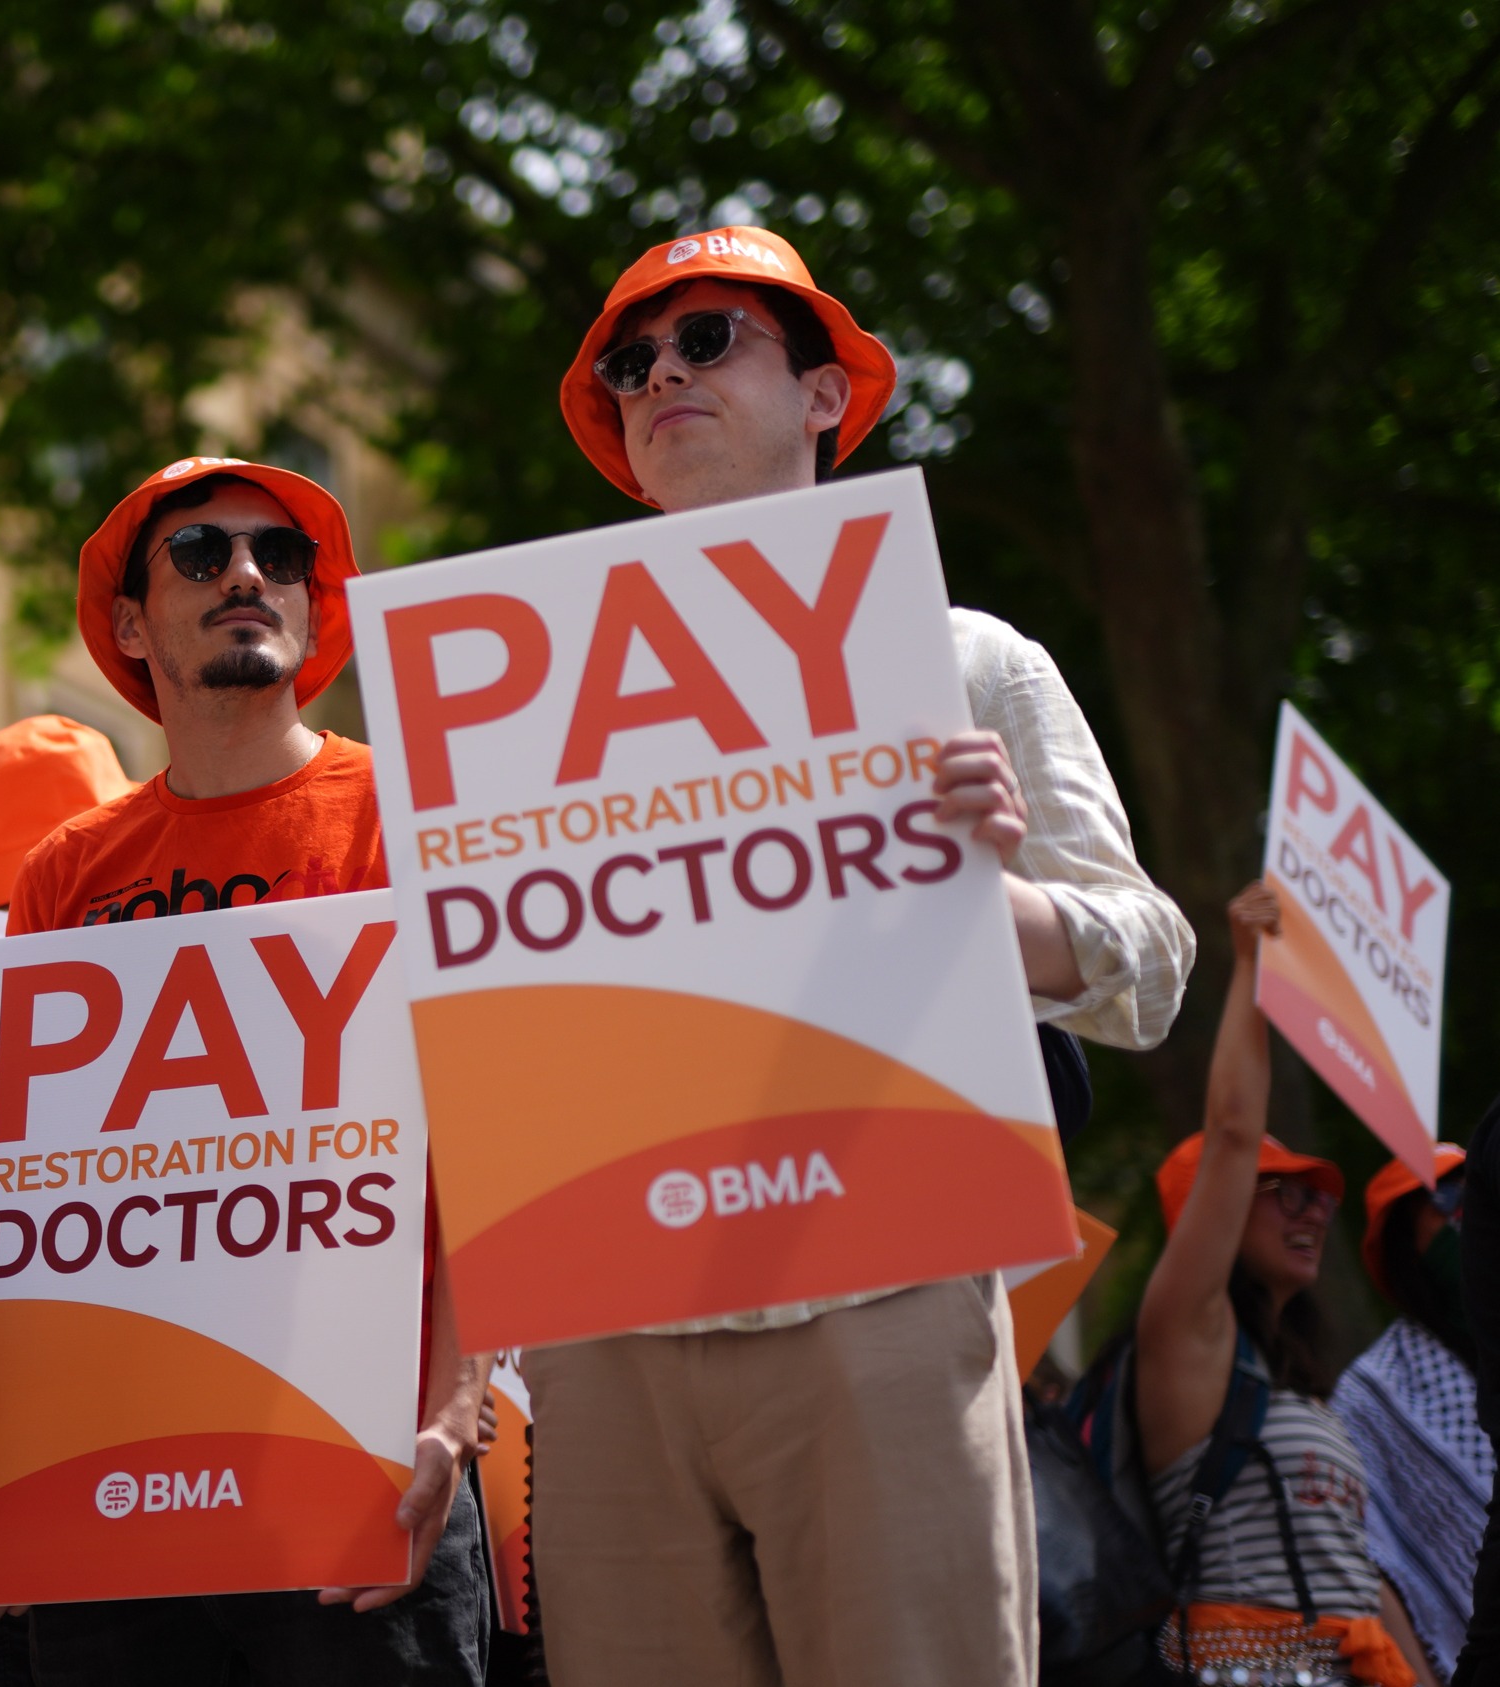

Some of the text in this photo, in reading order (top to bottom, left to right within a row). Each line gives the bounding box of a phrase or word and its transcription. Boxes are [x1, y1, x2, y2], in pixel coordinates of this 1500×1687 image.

[707, 235, 787, 272] BMA
[383, 511, 892, 813] PAY
[416, 736, 940, 872] RESTORATION FOR
[1286, 729, 1438, 944] PAY
[425, 798, 964, 970] DOCTORS
[1279, 838, 1432, 1031] DOCTORS
[308, 1118, 400, 1163] FOR
[708, 1150, 846, 1217] BMA
[143, 1468, 244, 1513] BMA
